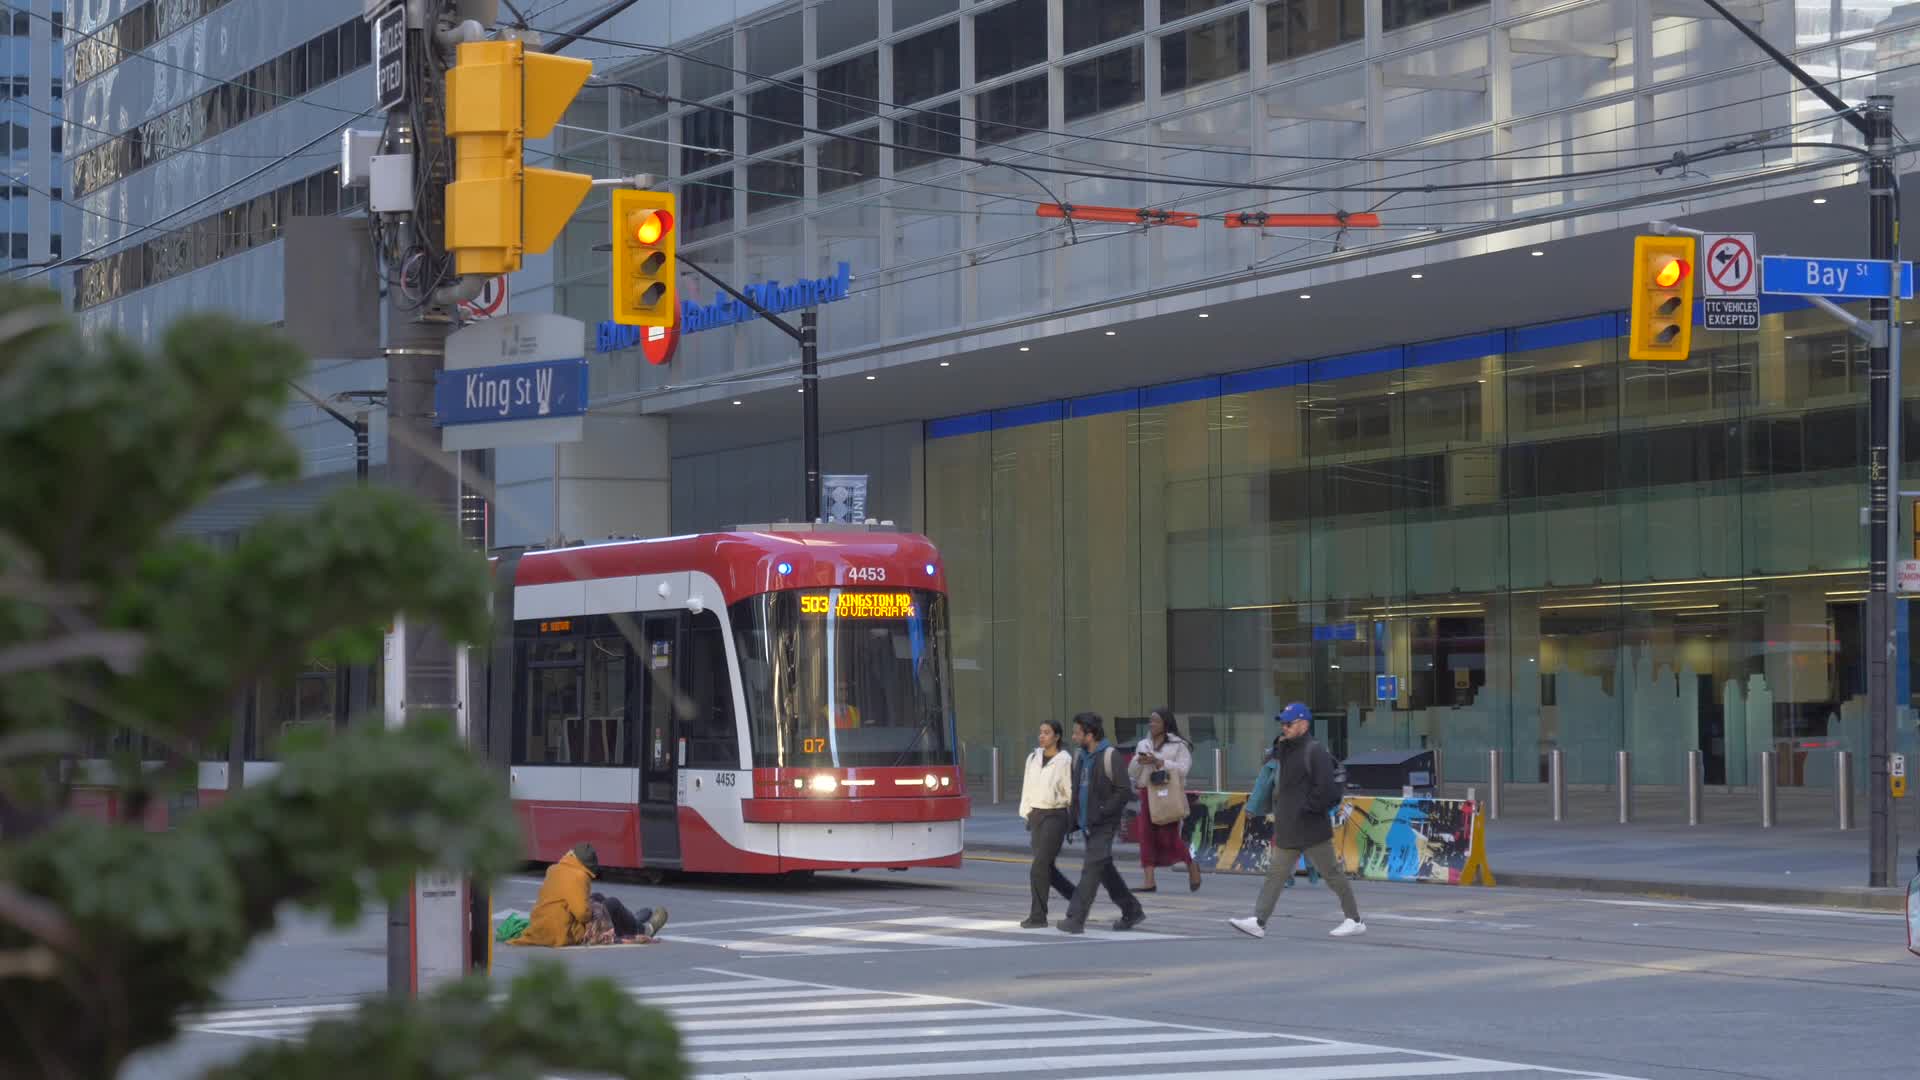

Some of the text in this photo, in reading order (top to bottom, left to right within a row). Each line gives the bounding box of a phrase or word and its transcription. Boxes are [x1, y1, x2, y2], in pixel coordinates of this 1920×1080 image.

[1807, 261, 1869, 292] Bay St
[681, 290, 734, 335] Bank
[754, 261, 850, 315] Montreal
[1706, 301, 1758, 312] TTC VEHICLES
[1708, 314, 1756, 325] EXCEPTED
[465, 367, 552, 415] King St W
[848, 567, 886, 582] 4453
[801, 596, 829, 613] 503
[838, 594, 911, 607] KINGSTON RD
[835, 606, 849, 617] TO
[901, 606, 915, 617] PK
[803, 738, 825, 753] 07
[715, 772, 736, 787] 4453
